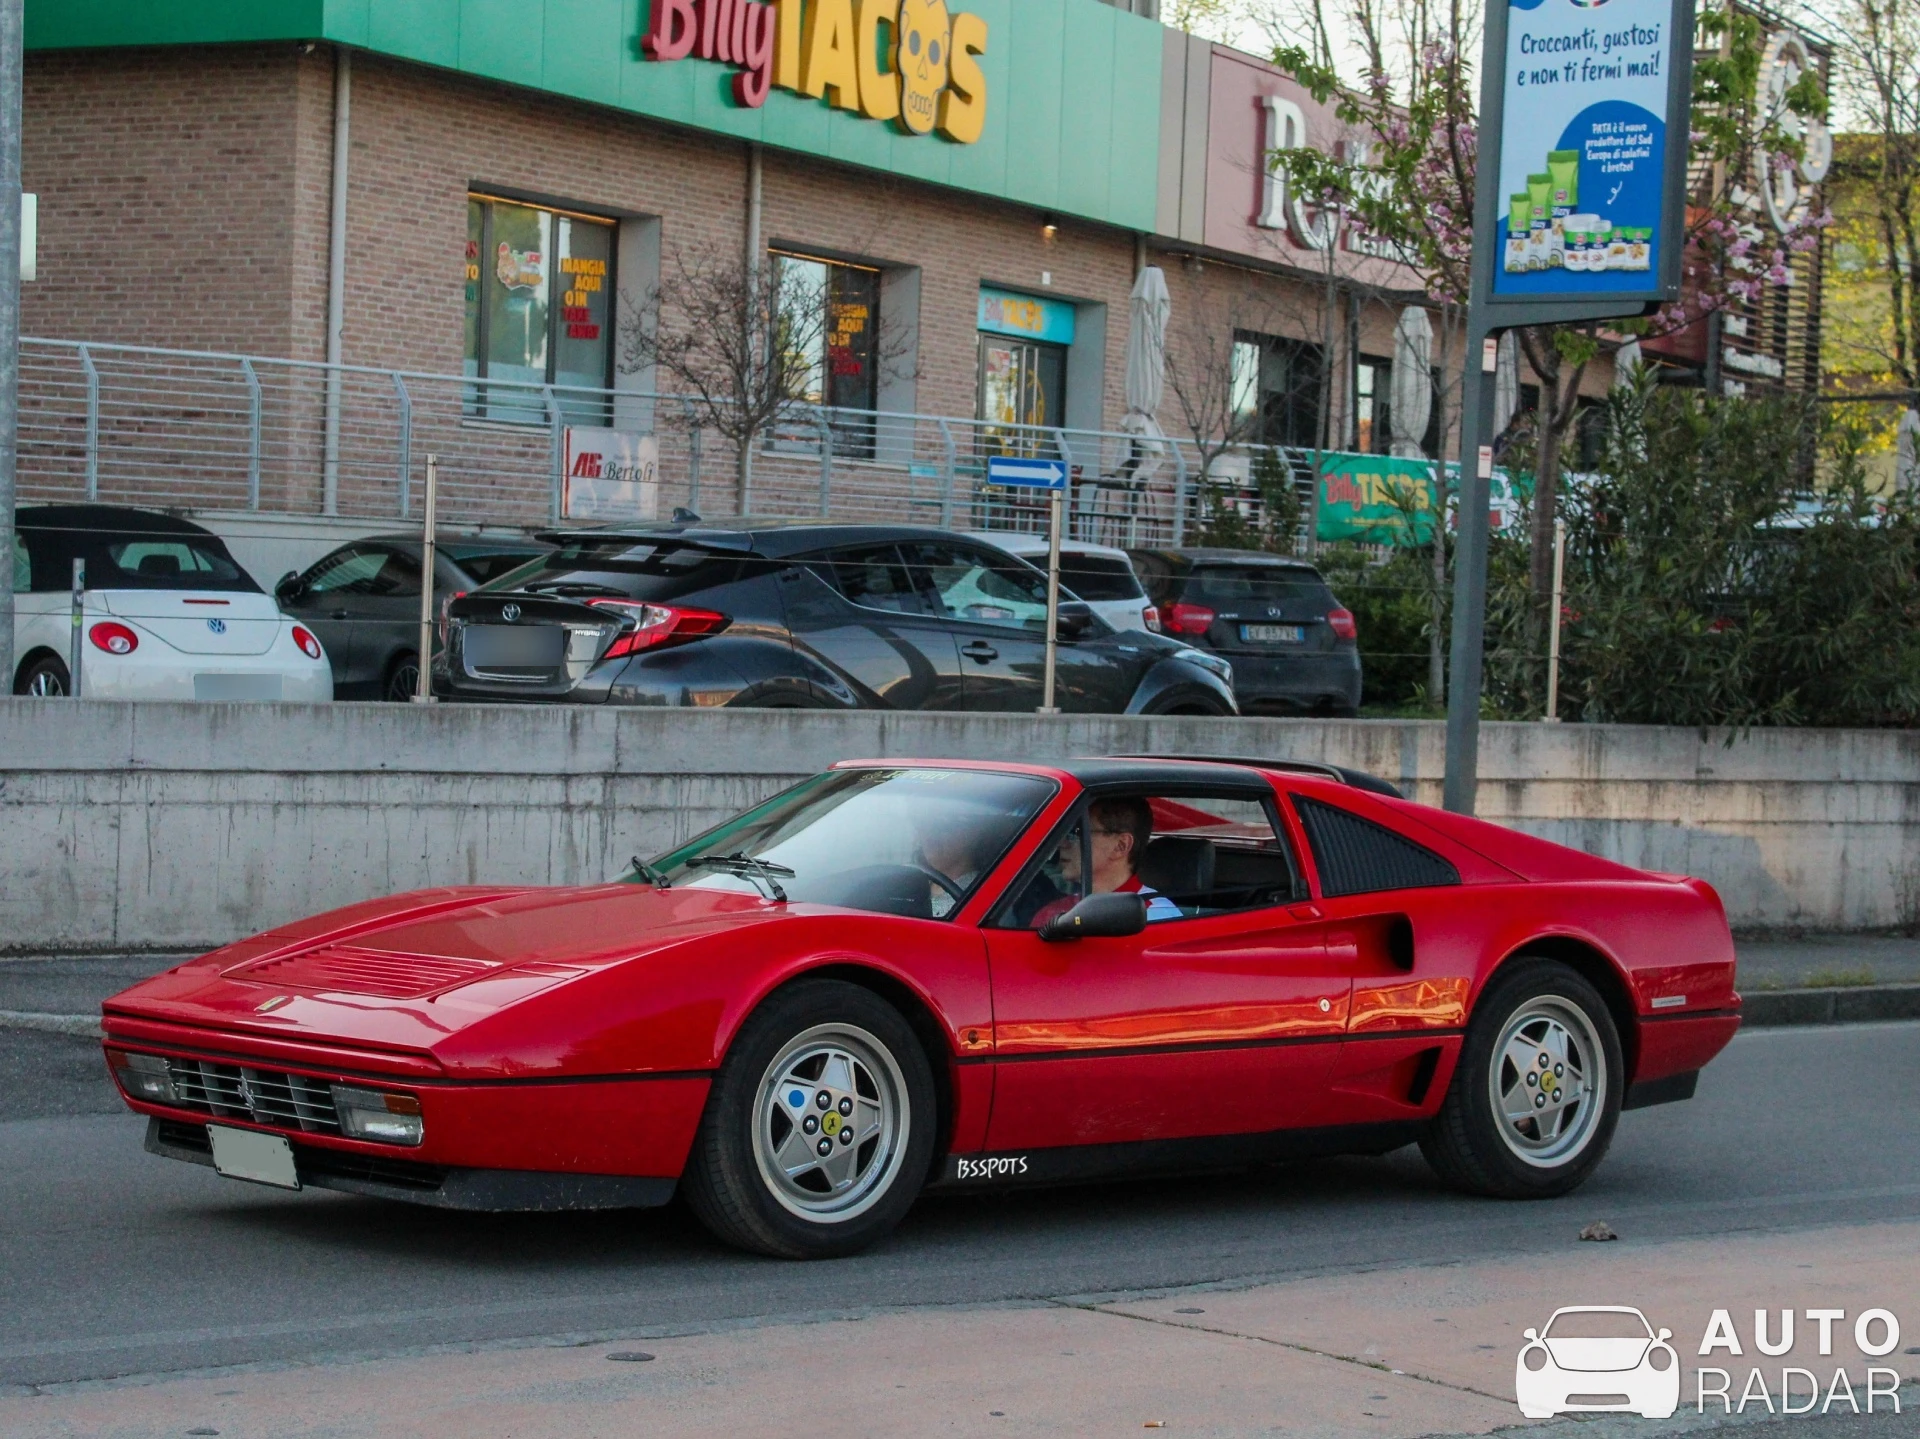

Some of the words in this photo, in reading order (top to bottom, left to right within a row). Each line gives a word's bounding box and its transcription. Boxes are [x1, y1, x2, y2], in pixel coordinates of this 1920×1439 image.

[1520, 28, 1598, 54] Croccanti,
[1603, 23, 1661, 54] gustosi
[1517, 70, 1525, 86] e
[1530, 68, 1559, 86] non
[1564, 61, 1577, 82] ti
[1582, 56, 1622, 82] fermi
[1627, 51, 1660, 78] mai!
[561, 258, 606, 276] MANGIA
